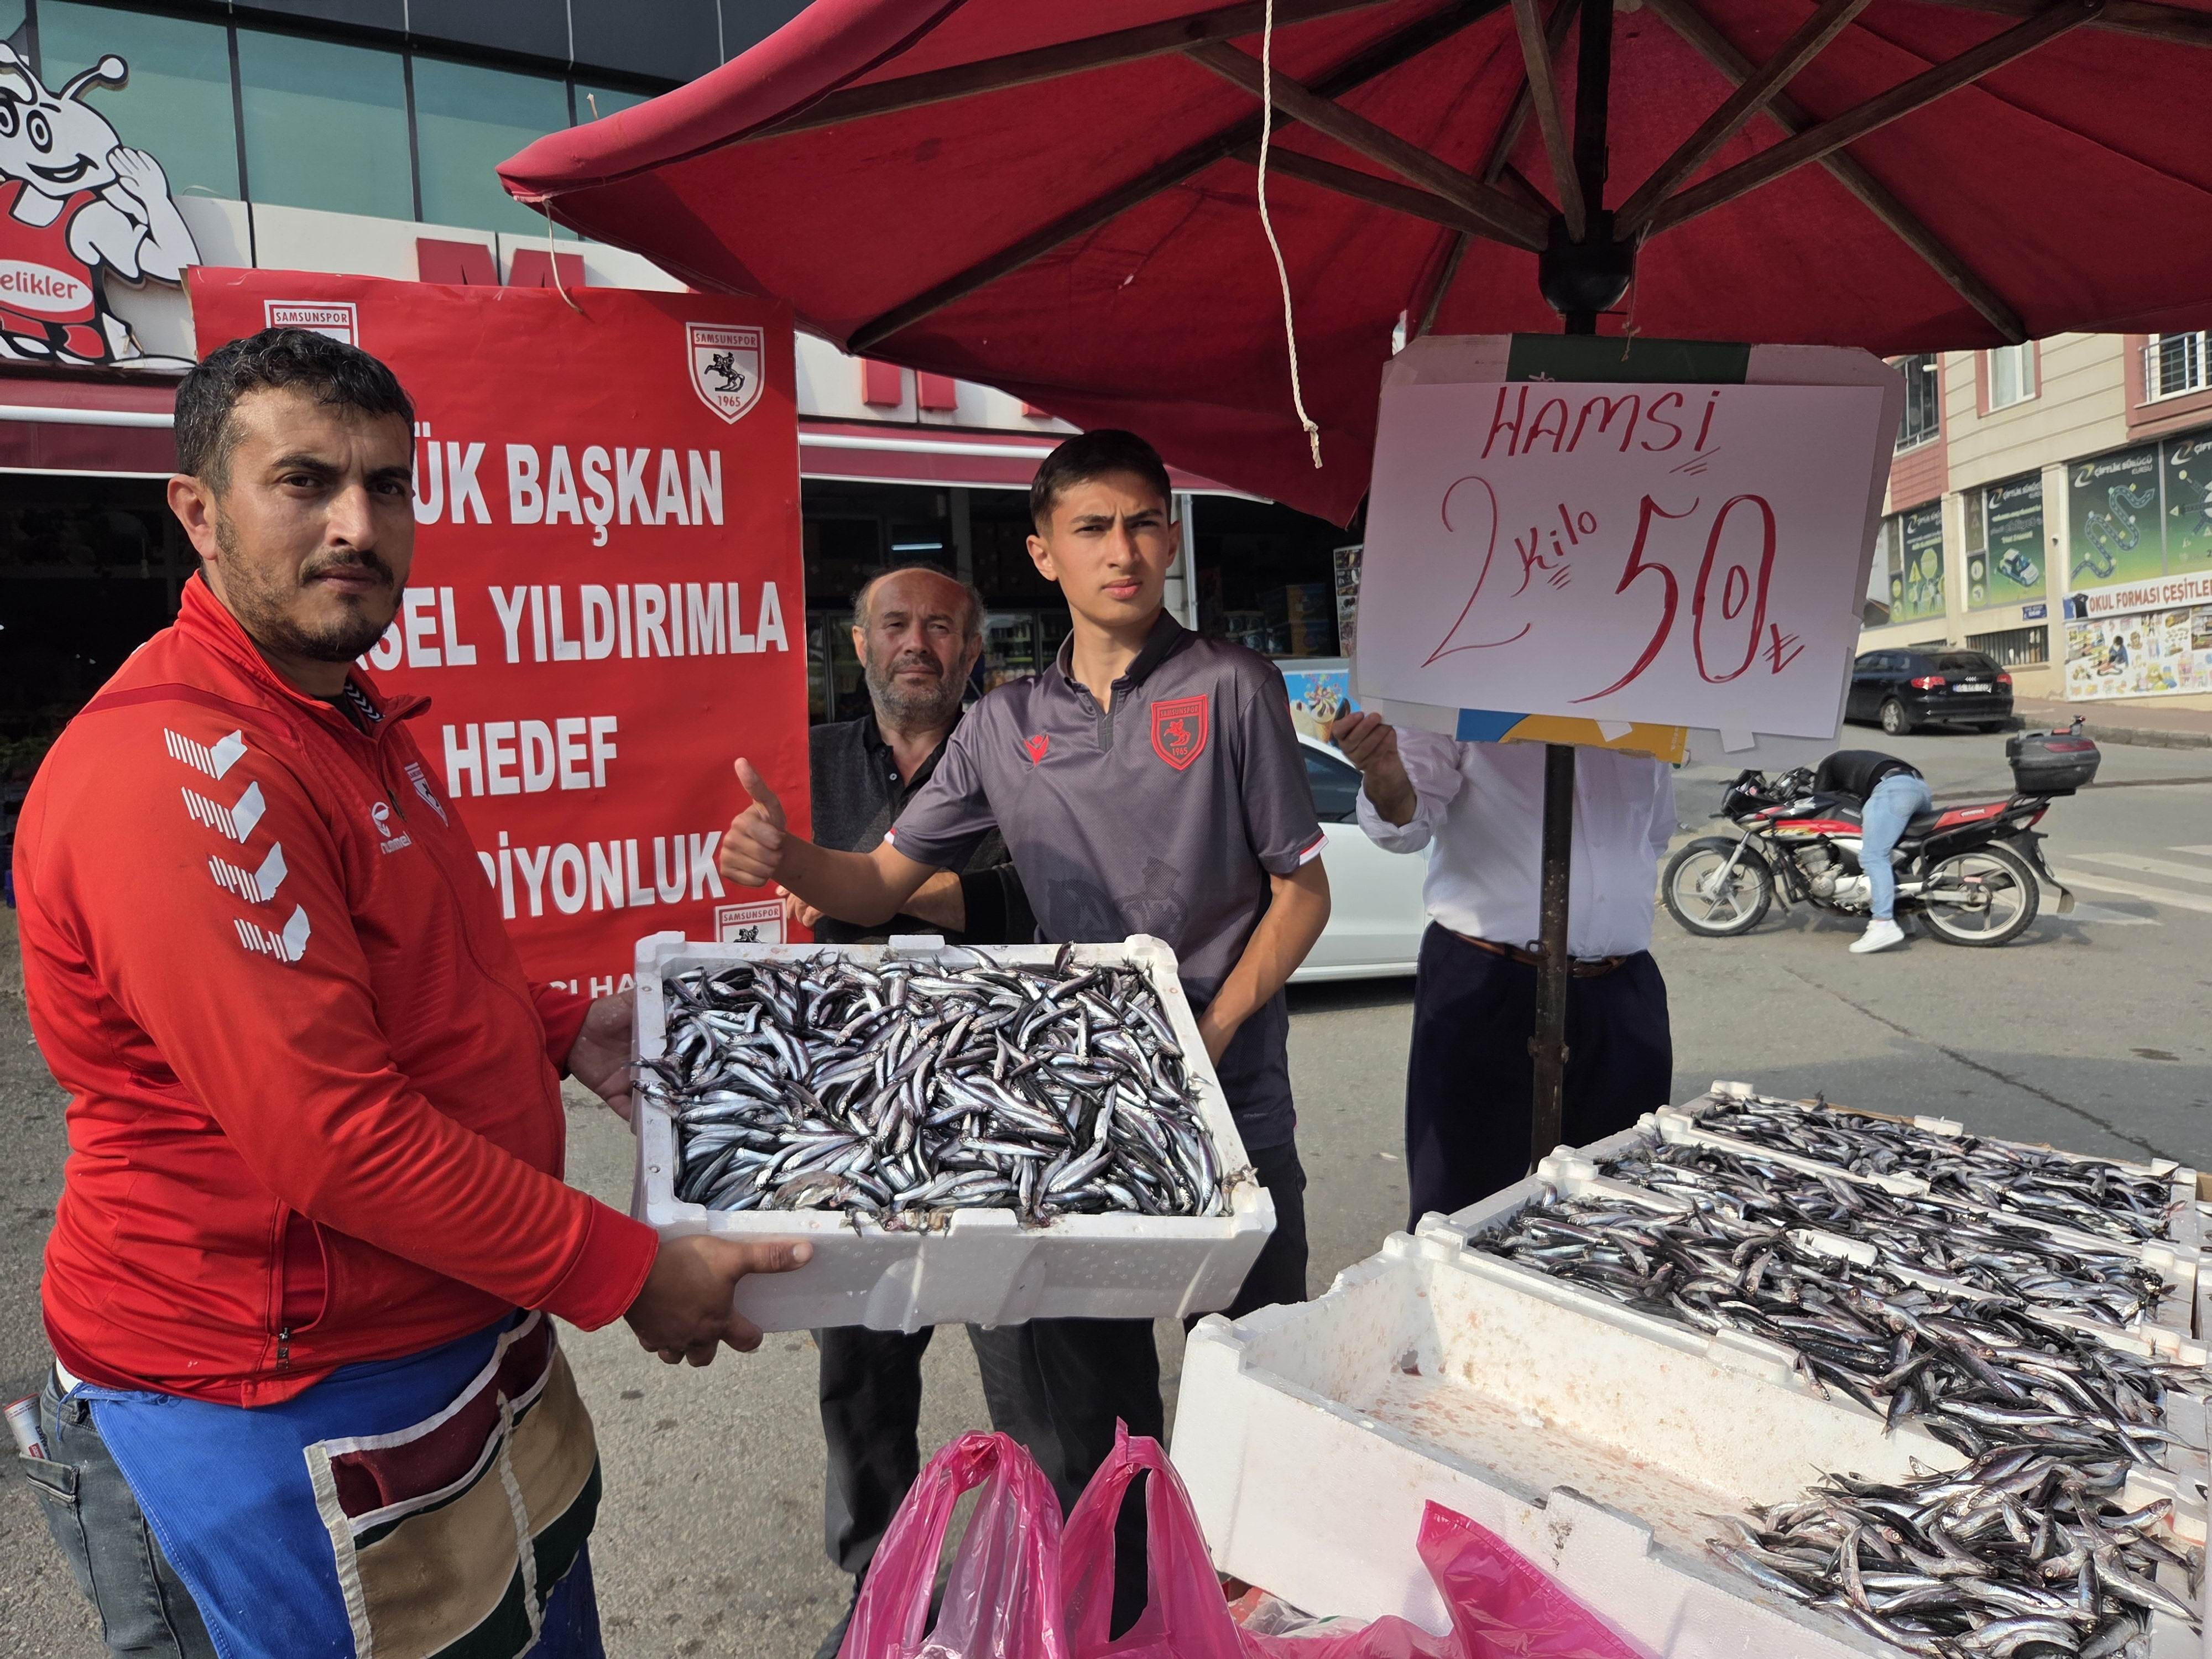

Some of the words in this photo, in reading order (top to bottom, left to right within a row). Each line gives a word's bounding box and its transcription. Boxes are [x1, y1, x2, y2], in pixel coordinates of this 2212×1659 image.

[276, 312, 347, 322] SAMSUNSPOR
[696, 333, 757, 346] SAMSUNSPOR
[718, 395, 741, 407] 1965
[505, 443, 723, 547] BAŞKAN
[1421, 476, 1531, 667] 2
[2089, 593, 2114, 612] OKUL
[2116, 586, 2160, 608] FORMASI
[2163, 577, 2212, 604] ÇEŞİTLE
[356, 586, 477, 671] SEL
[488, 581, 789, 664] YILDIRIMLA
[1160, 706, 1199, 717] SAMSUNSPOR
[442, 716, 617, 798] HEDEF
[1172, 747, 1188, 756] 1965
[723, 908, 779, 922] SAMSUNSPOR
